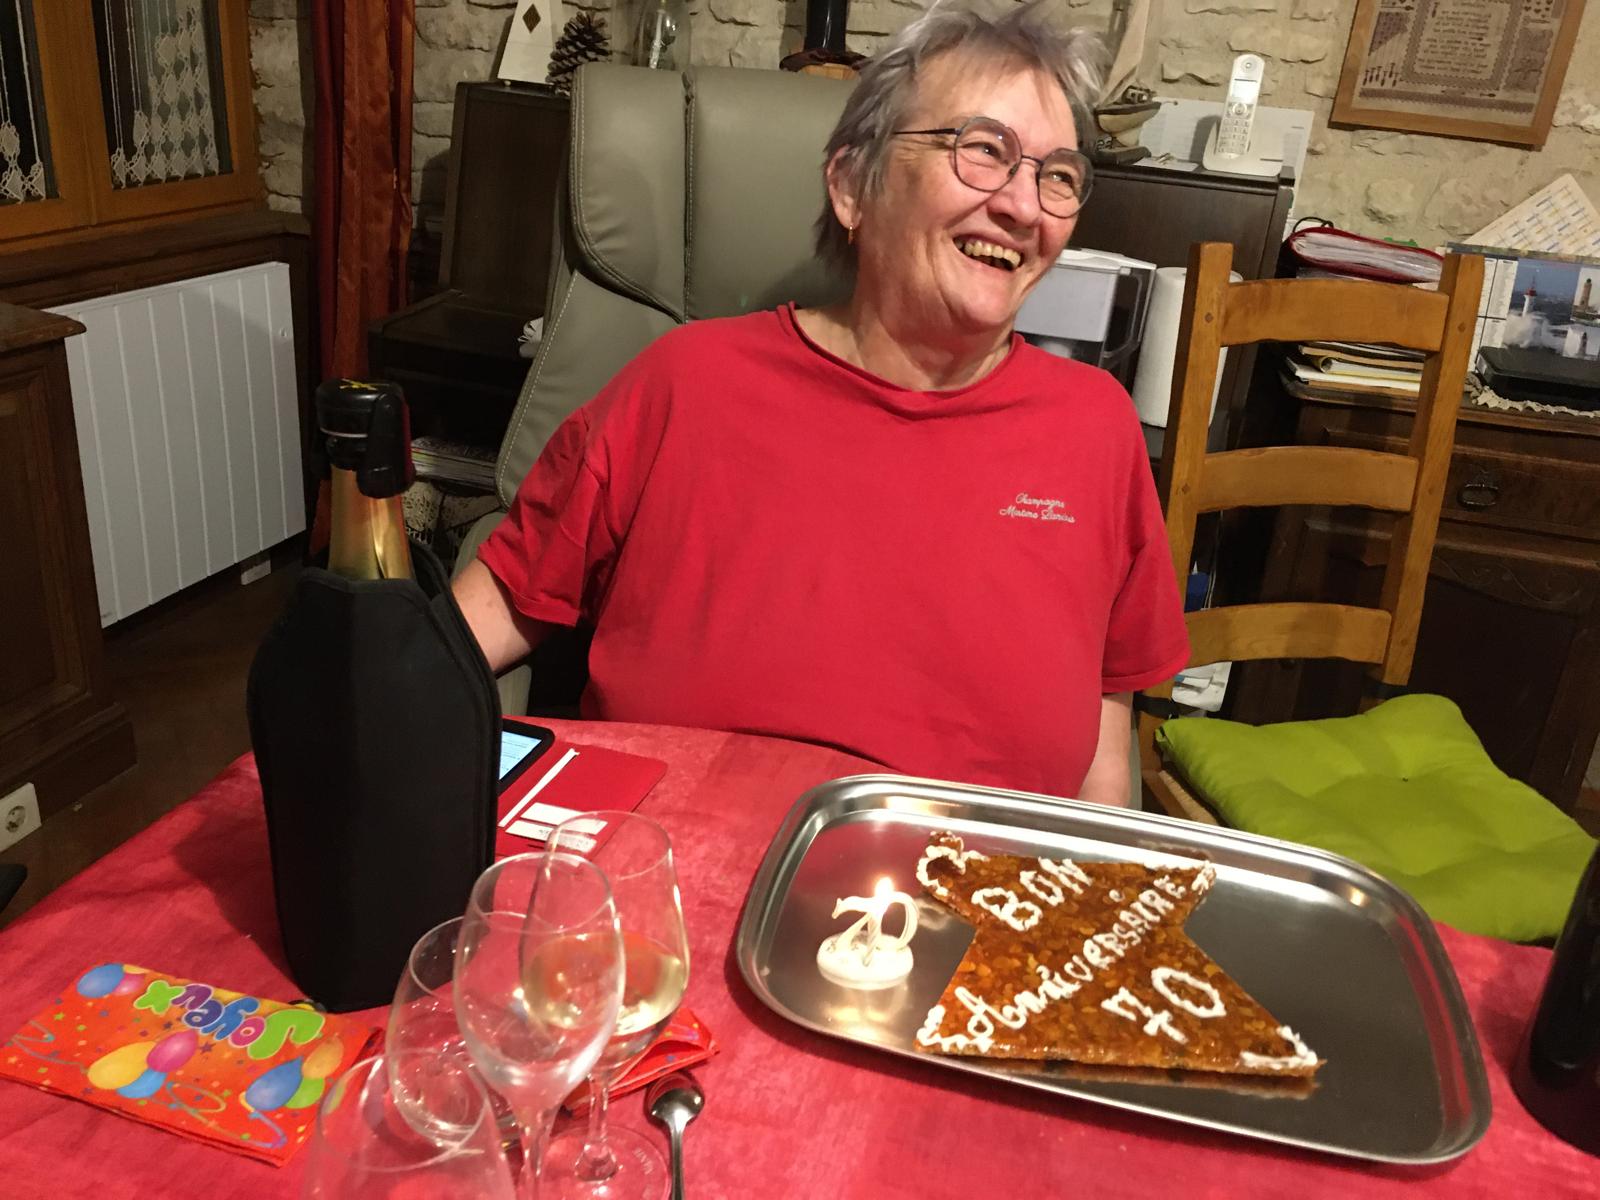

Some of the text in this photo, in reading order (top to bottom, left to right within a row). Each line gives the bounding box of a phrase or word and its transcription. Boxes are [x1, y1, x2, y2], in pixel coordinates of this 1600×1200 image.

[831, 891, 920, 951] 70
[971, 857, 1092, 931] BON
[133, 979, 325, 1060] Joyeux
[1100, 966, 1226, 1044] 70
